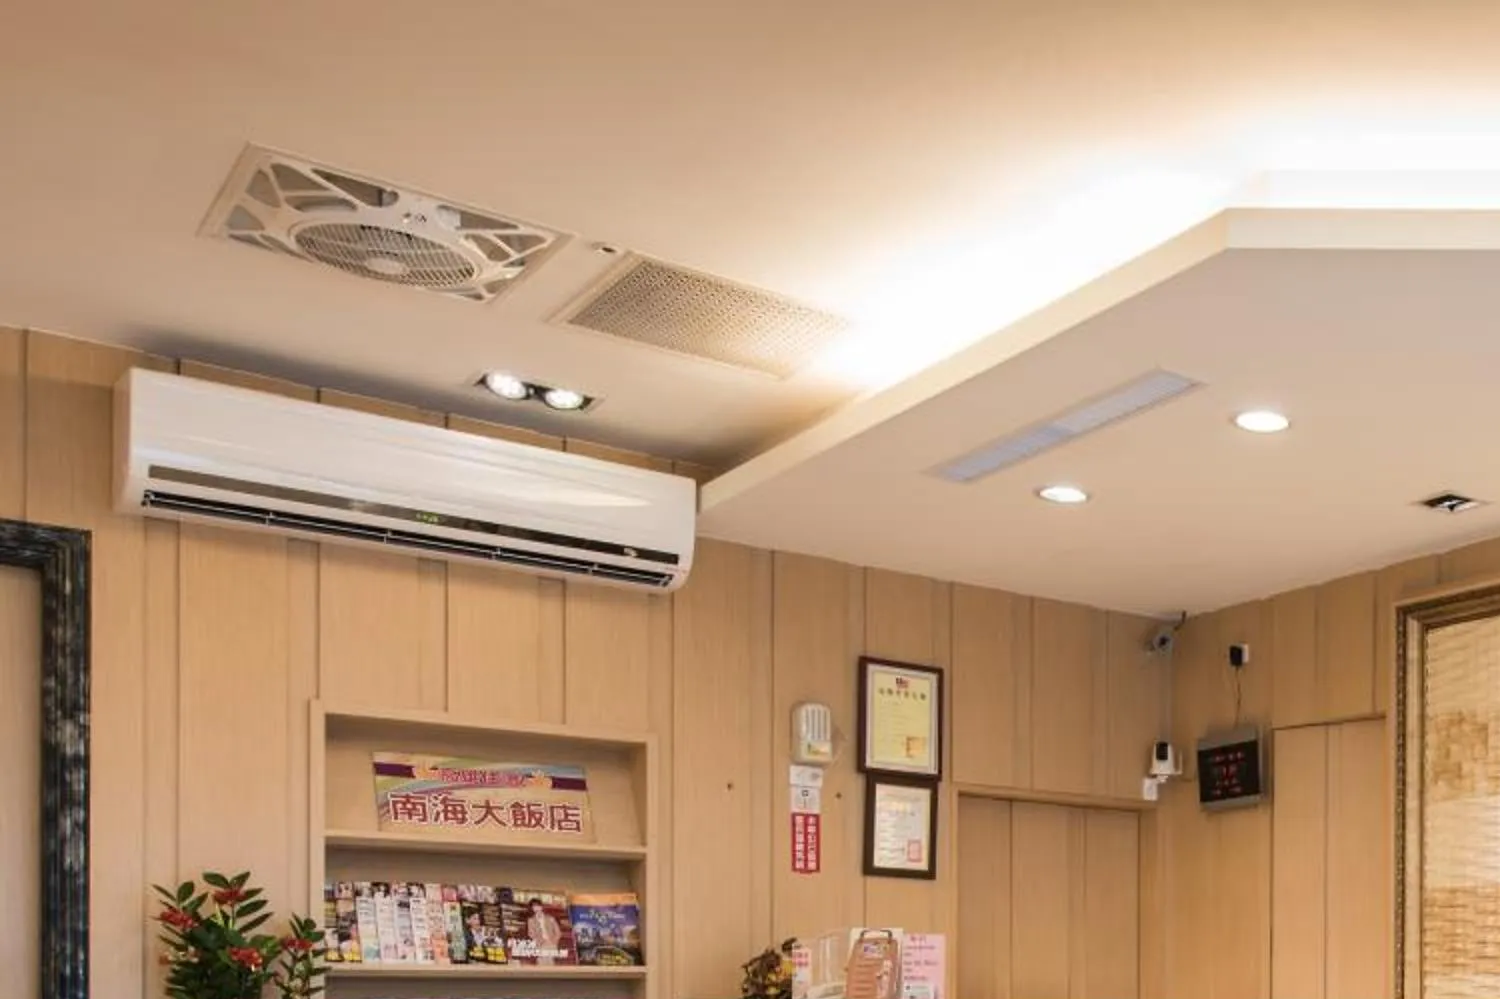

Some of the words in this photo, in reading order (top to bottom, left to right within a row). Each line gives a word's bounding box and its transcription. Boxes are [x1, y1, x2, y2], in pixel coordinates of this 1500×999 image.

[389, 792, 582, 832] 南海大飯店
